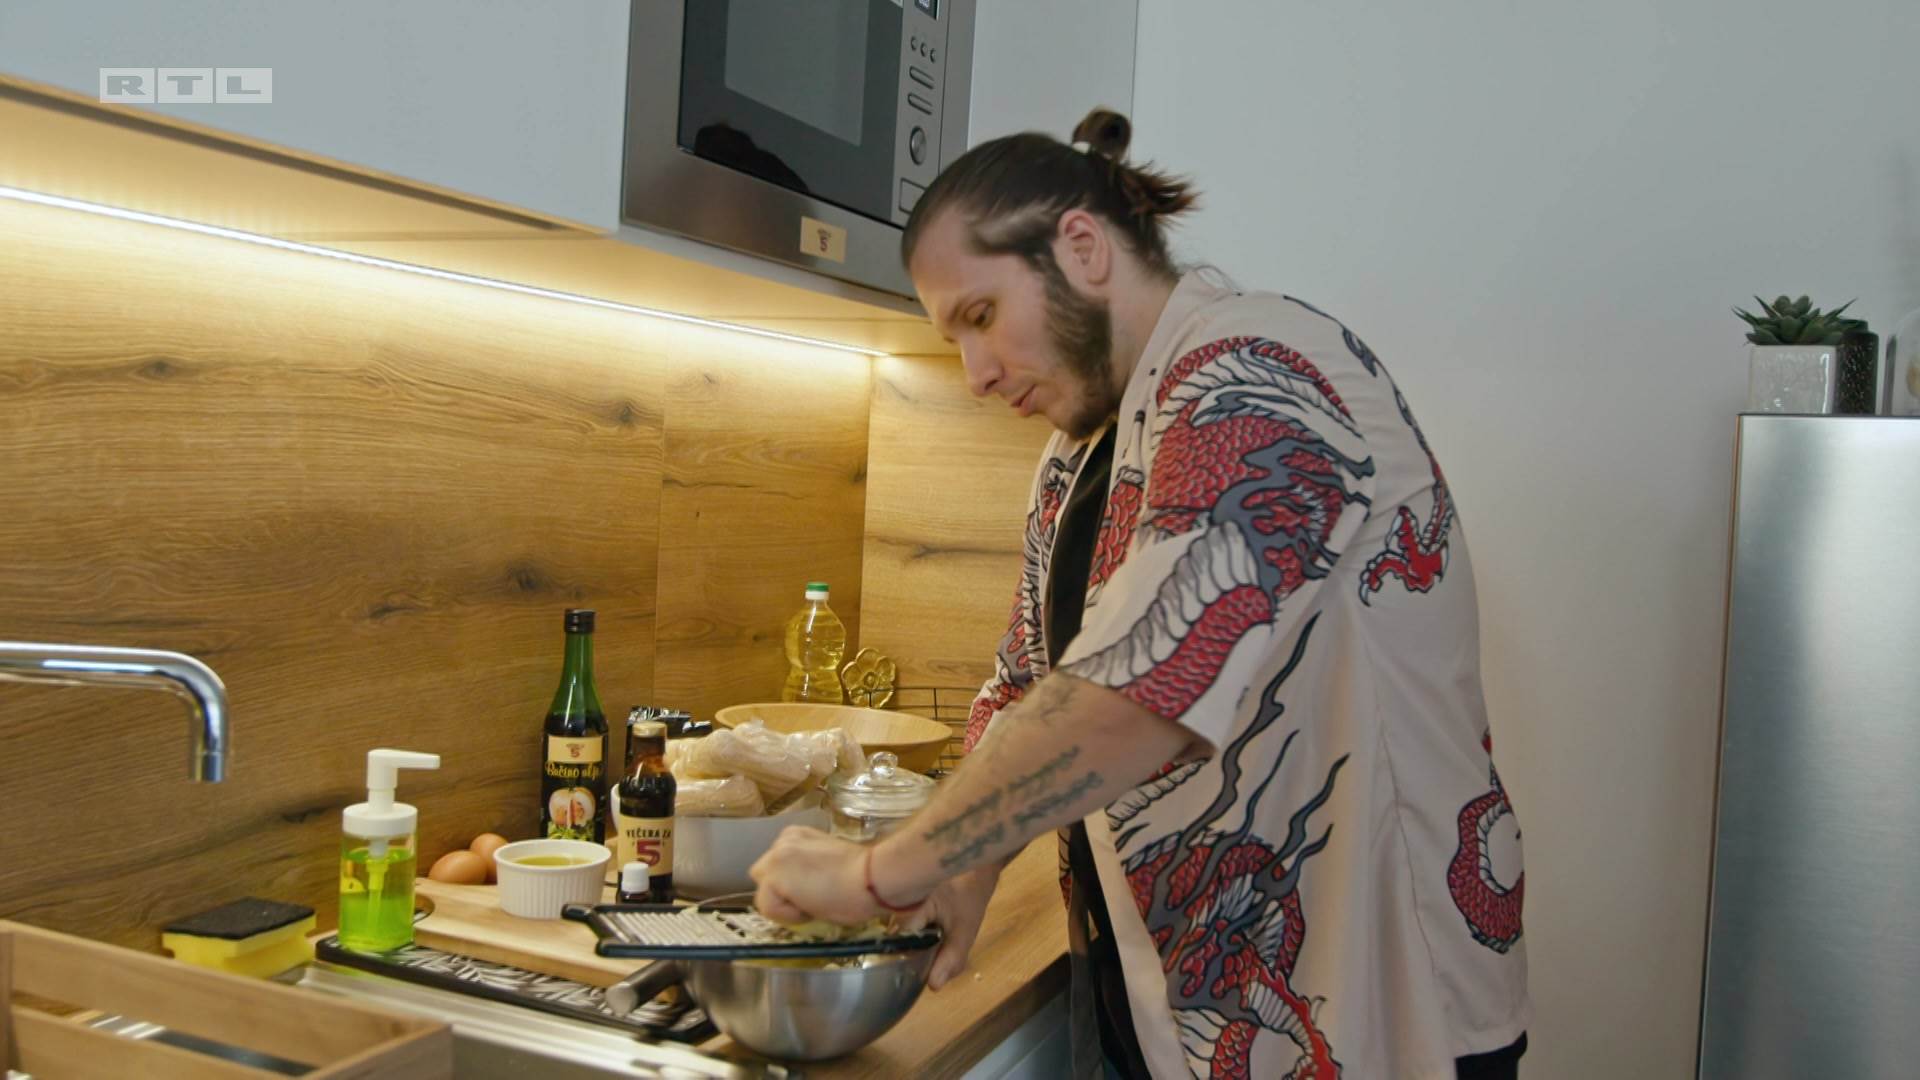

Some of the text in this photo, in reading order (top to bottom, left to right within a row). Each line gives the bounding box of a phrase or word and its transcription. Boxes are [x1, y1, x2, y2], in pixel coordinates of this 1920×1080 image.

[570, 747, 581, 758] 5
[626, 827, 660, 838] VEČERA
[636, 840, 661, 867] 5
